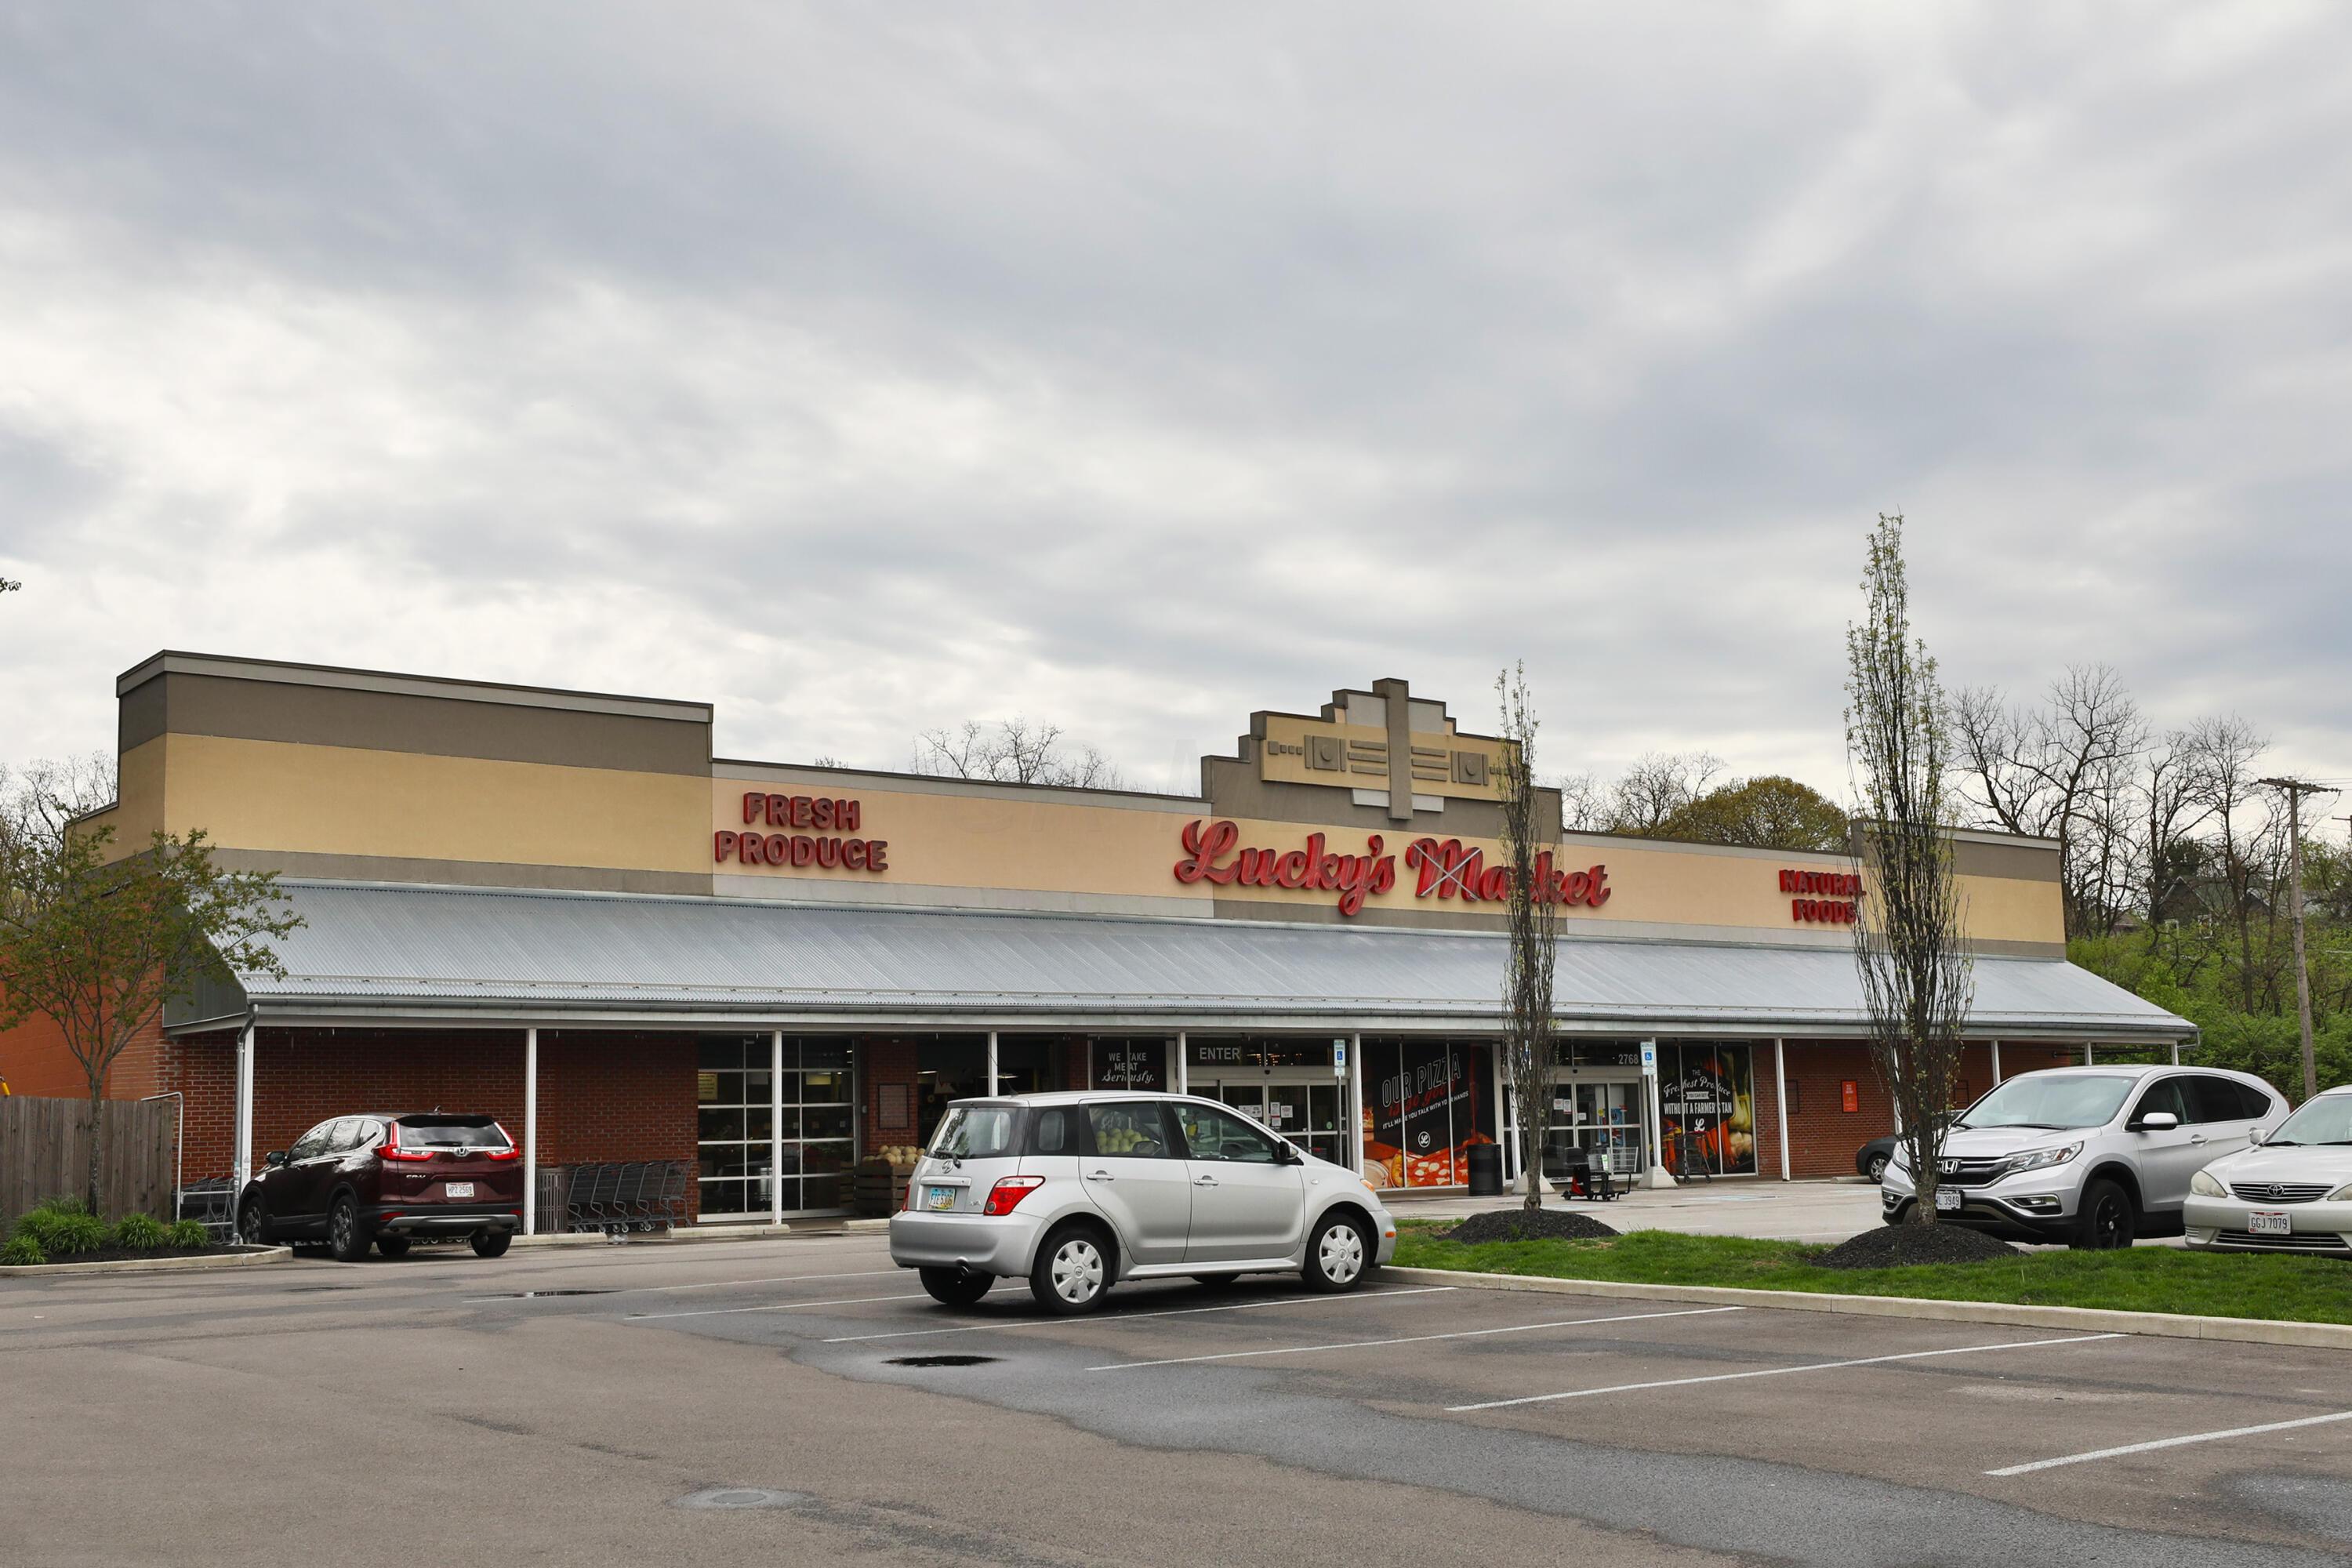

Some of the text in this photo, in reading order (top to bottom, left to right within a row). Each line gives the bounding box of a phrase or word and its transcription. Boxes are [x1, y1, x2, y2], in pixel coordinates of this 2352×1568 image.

[743, 792, 861, 831] FRESH
[714, 830, 889, 871] PRODUCE
[1174, 818, 1611, 916] Lucky's Maket
[1779, 869, 1867, 898] NATURAL
[1792, 898, 1857, 924] FOODS
[1109, 1052, 1121, 1062] WE
[1114, 1062, 1138, 1071] MEAT
[1199, 1047, 1240, 1060] ENTER
[1618, 1054, 1639, 1065] 2768
[1382, 1072, 1412, 1108] OUR
[1394, 1115, 1408, 1125] MAE
[1408, 1111, 1417, 1120] YOU
[1417, 1107, 1429, 1116] TALK
[1429, 1102, 1442, 1111] WITH
[1441, 1097, 1454, 1106] YOR
[1454, 1091, 1469, 1101] HANDS
[1690, 1102, 1694, 1115] A
[1721, 1102, 1733, 1114] TAN
[2251, 1217, 2288, 1229] GGJ 7079
